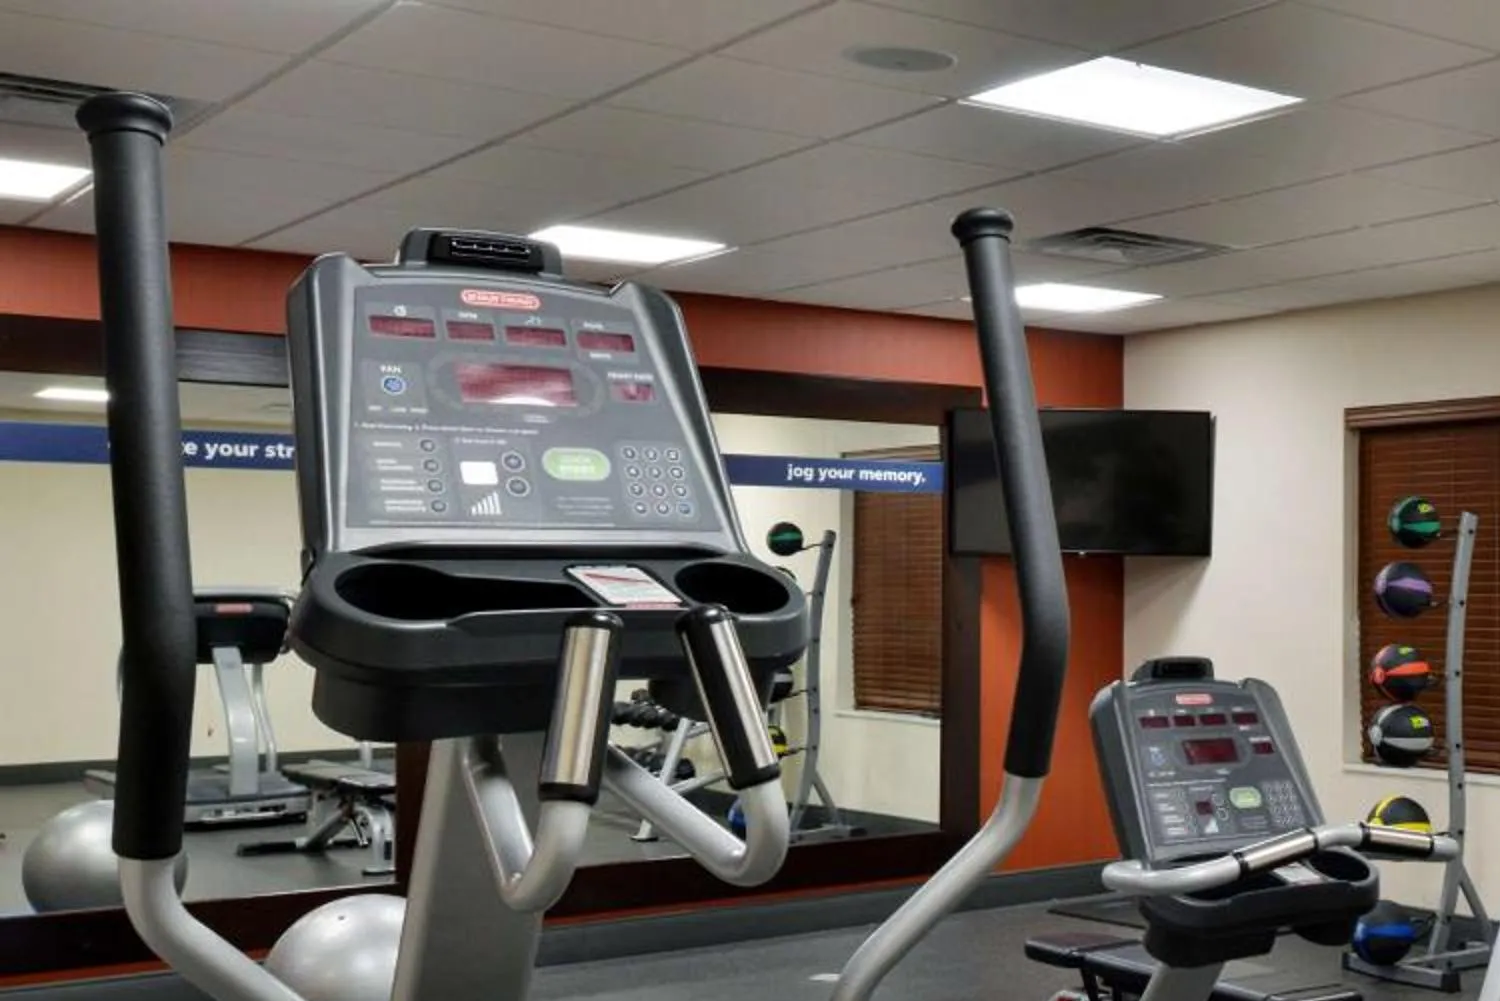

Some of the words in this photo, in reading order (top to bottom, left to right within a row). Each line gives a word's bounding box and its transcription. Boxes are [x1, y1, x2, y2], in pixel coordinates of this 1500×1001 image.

[204, 442, 260, 460] your
[264, 442, 296, 459] str
[786, 463, 815, 482] jog
[818, 466, 855, 482] your
[858, 468, 927, 487] memory.
